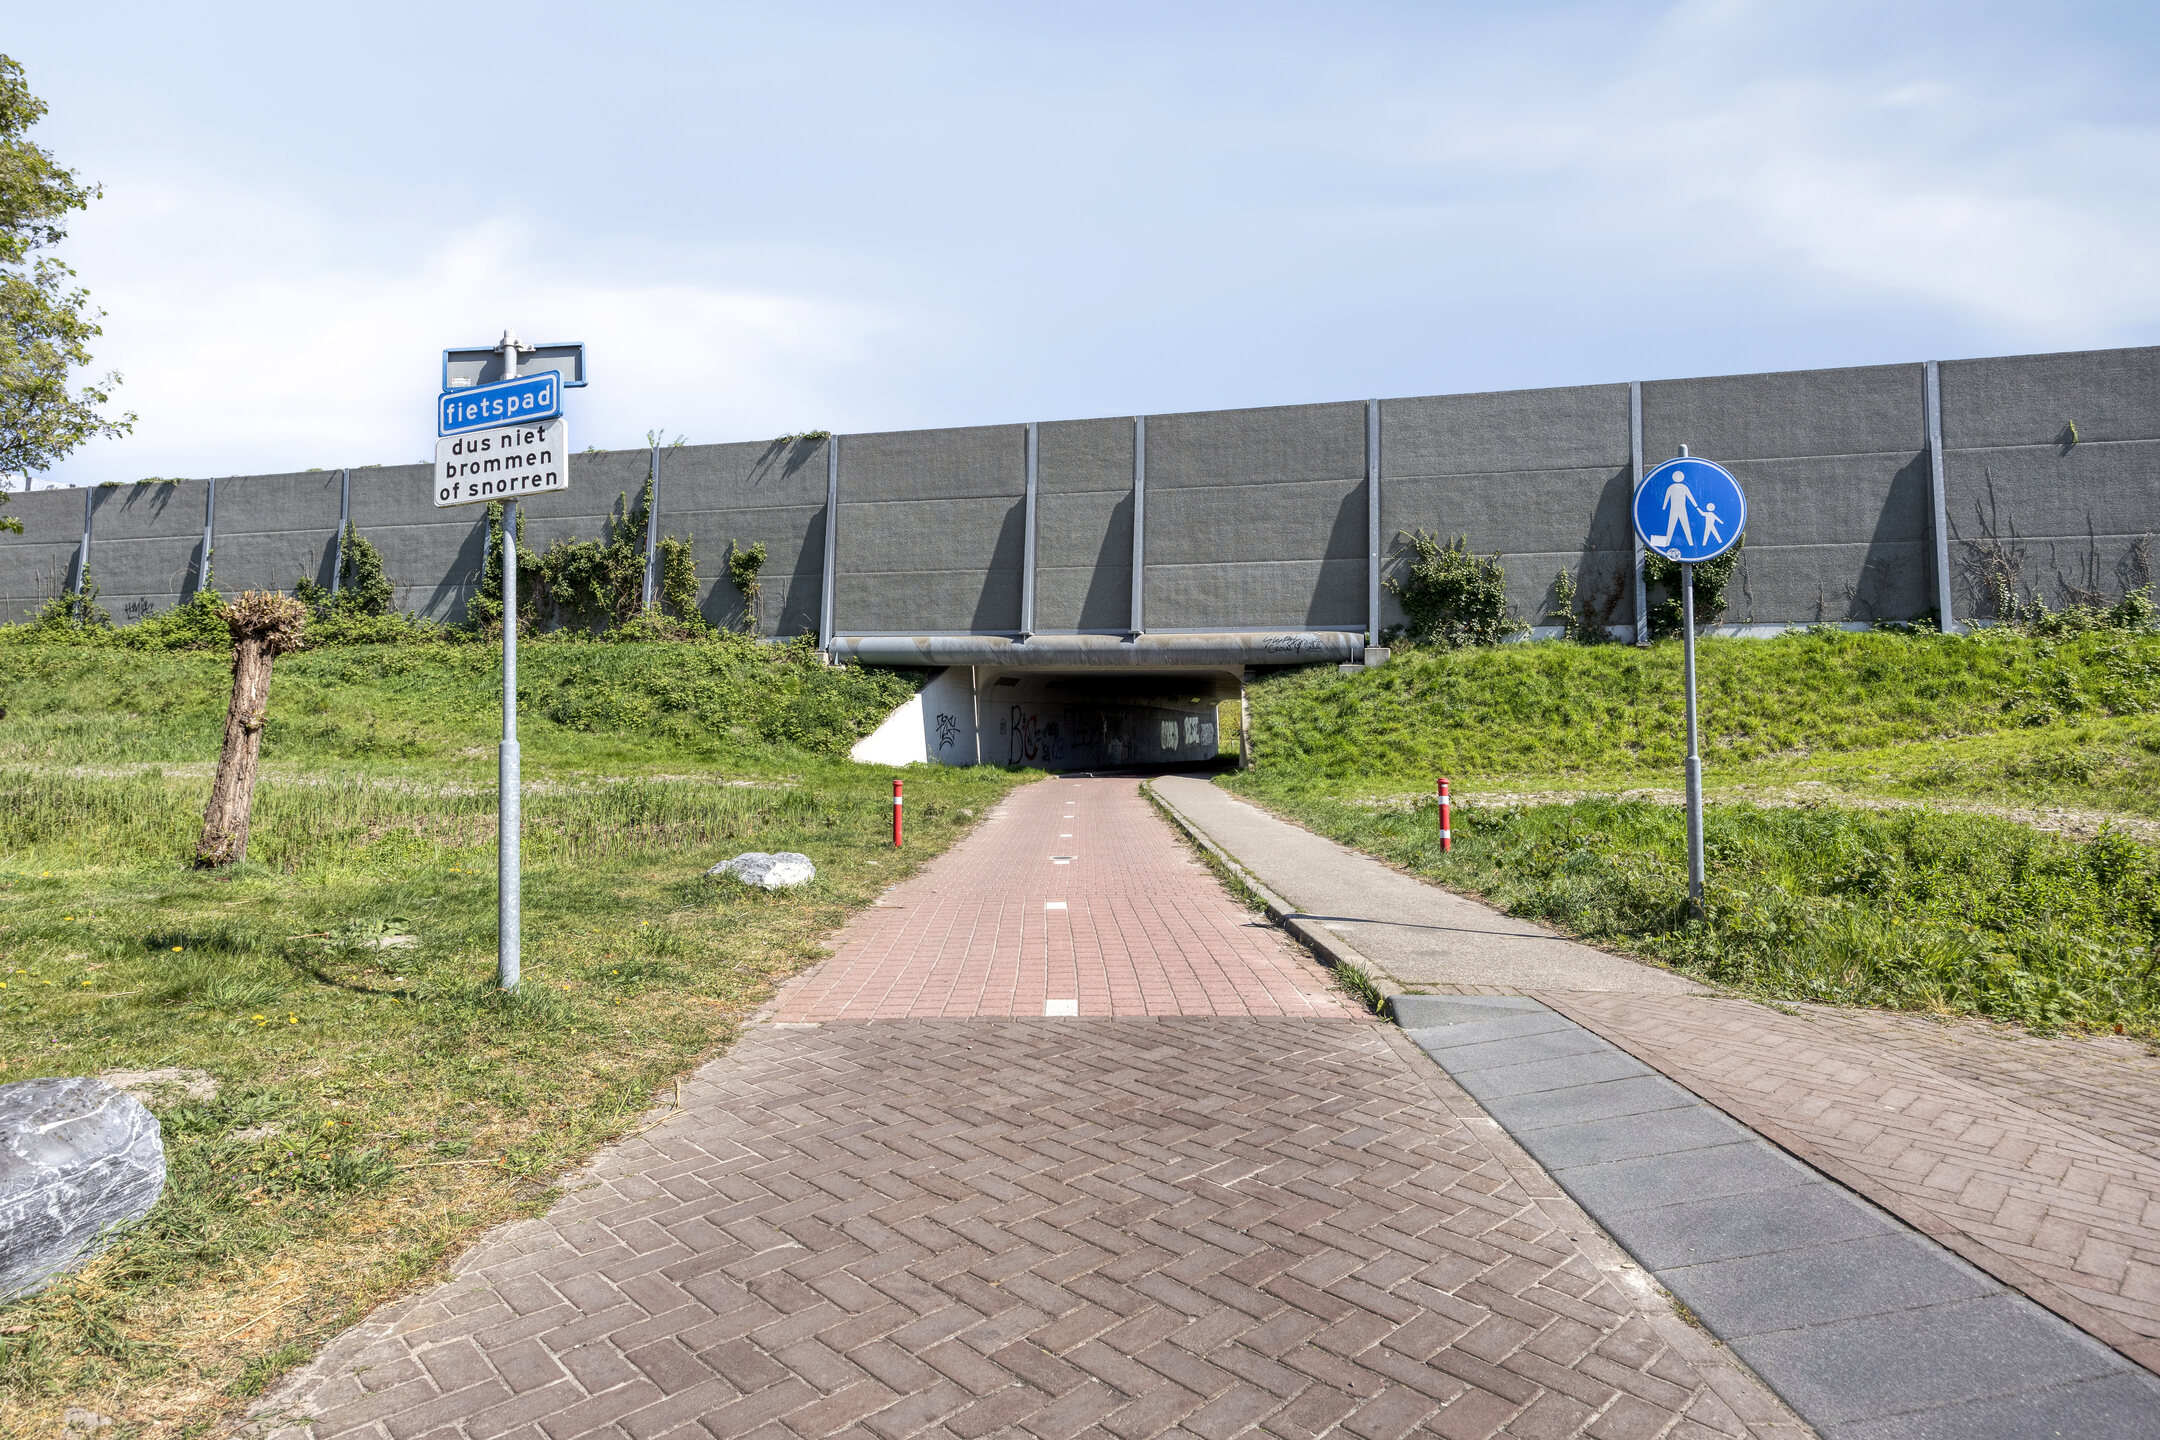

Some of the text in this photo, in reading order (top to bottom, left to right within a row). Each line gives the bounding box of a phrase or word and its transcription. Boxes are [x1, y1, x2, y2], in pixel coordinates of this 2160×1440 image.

[446, 384, 551, 424] fietspad
[452, 425, 546, 455] dus niet
[446, 450, 552, 478] brommen
[440, 471, 558, 501] of snorren
